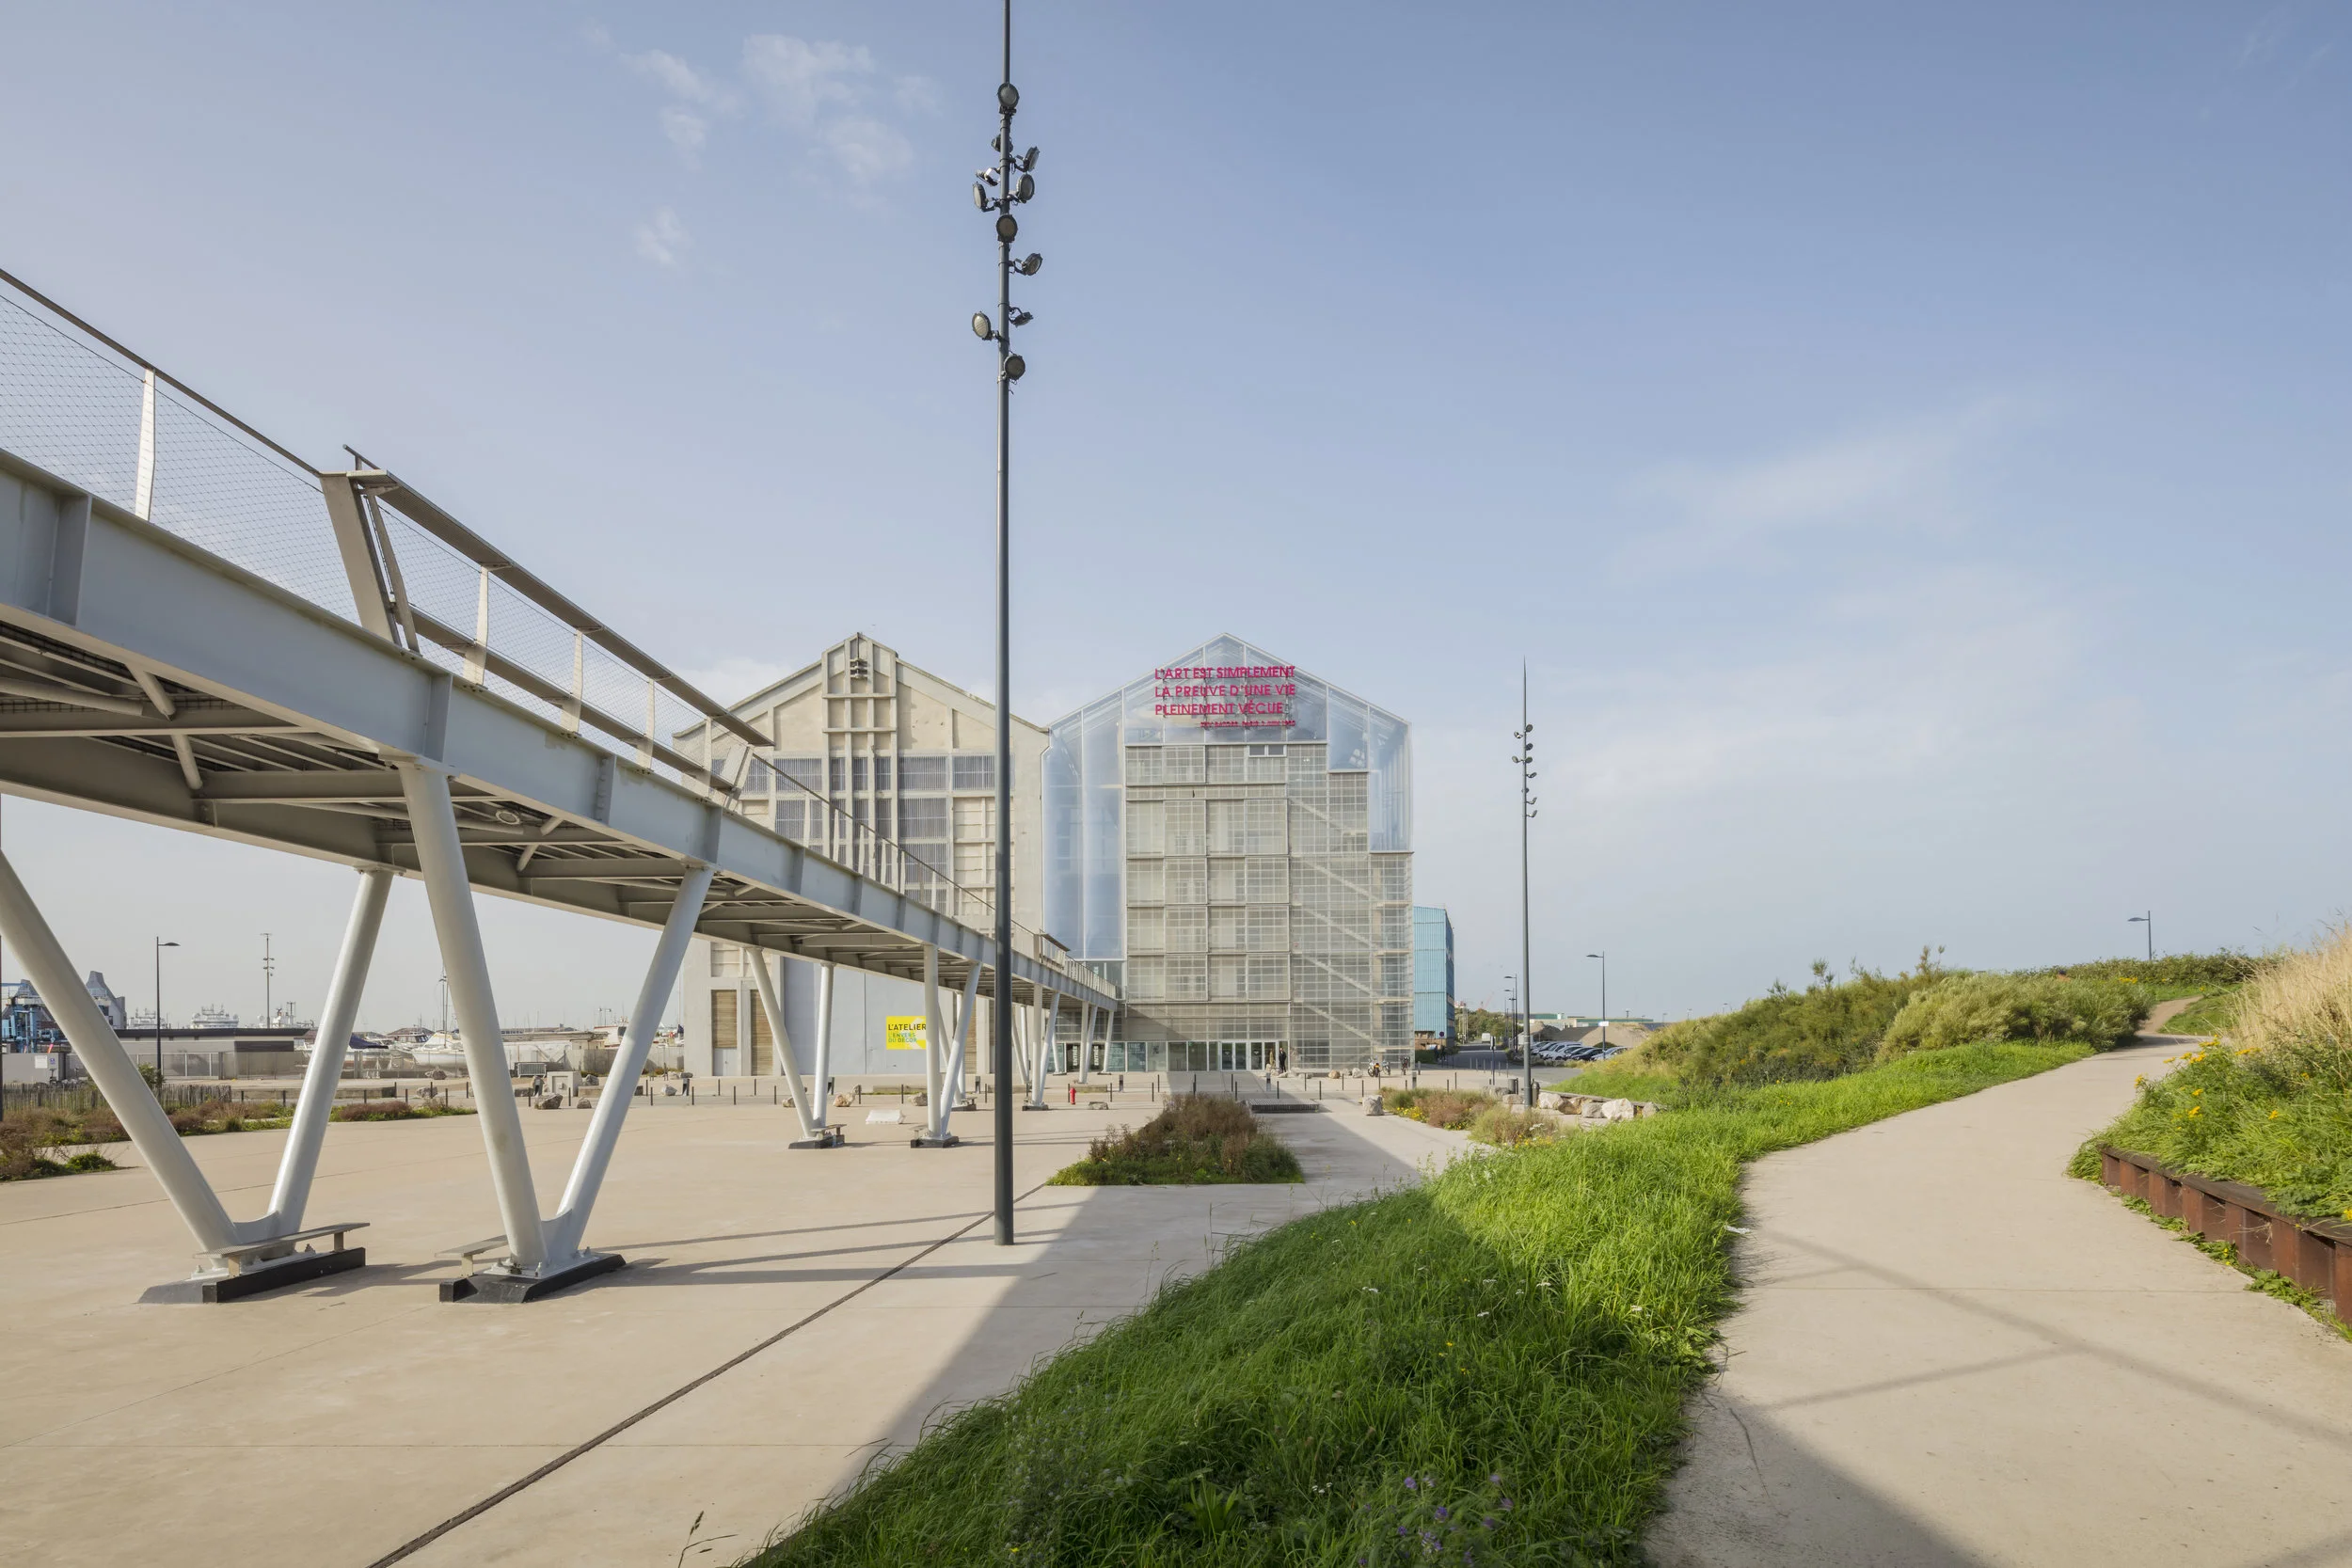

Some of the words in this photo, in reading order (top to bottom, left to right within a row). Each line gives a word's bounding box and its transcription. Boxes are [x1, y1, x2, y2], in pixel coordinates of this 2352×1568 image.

[1154, 668, 1190, 679] L'ART
[1193, 667, 1212, 679] EST
[1216, 665, 1295, 678] SIMPLEMENT
[1154, 686, 1171, 697] LA
[1175, 685, 1226, 696] PREUVE
[1230, 684, 1270, 696] D'UNE
[1275, 683, 1295, 696] VIE
[1154, 703, 1235, 715] PLEINEMENT
